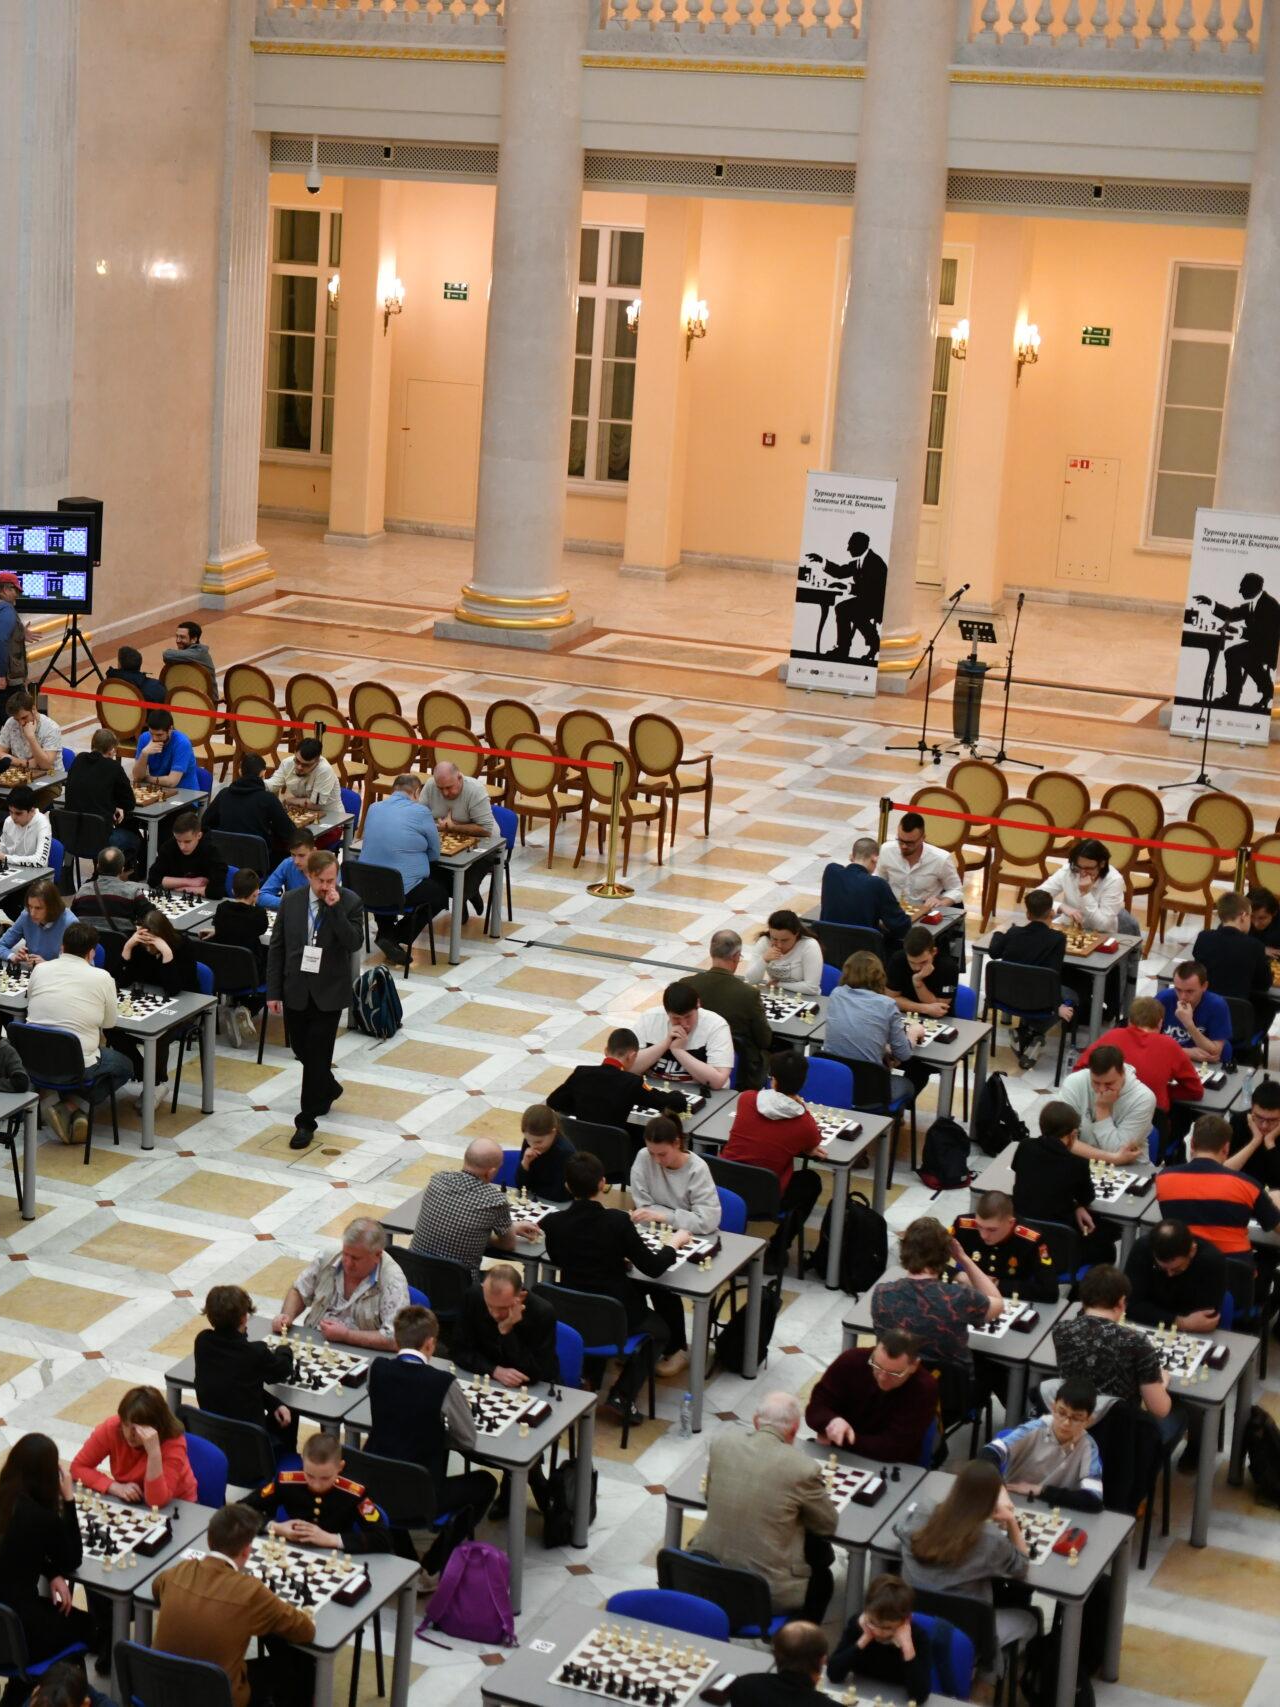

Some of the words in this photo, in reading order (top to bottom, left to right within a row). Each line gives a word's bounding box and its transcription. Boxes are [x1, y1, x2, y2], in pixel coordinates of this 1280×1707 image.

[814, 488, 836, 498] Турнир
[845, 494, 883, 502] шахматам
[1202, 536, 1231, 544] памяти
[1203, 527, 1228, 538] Турнир
[1238, 532, 1280, 542] шахматам
